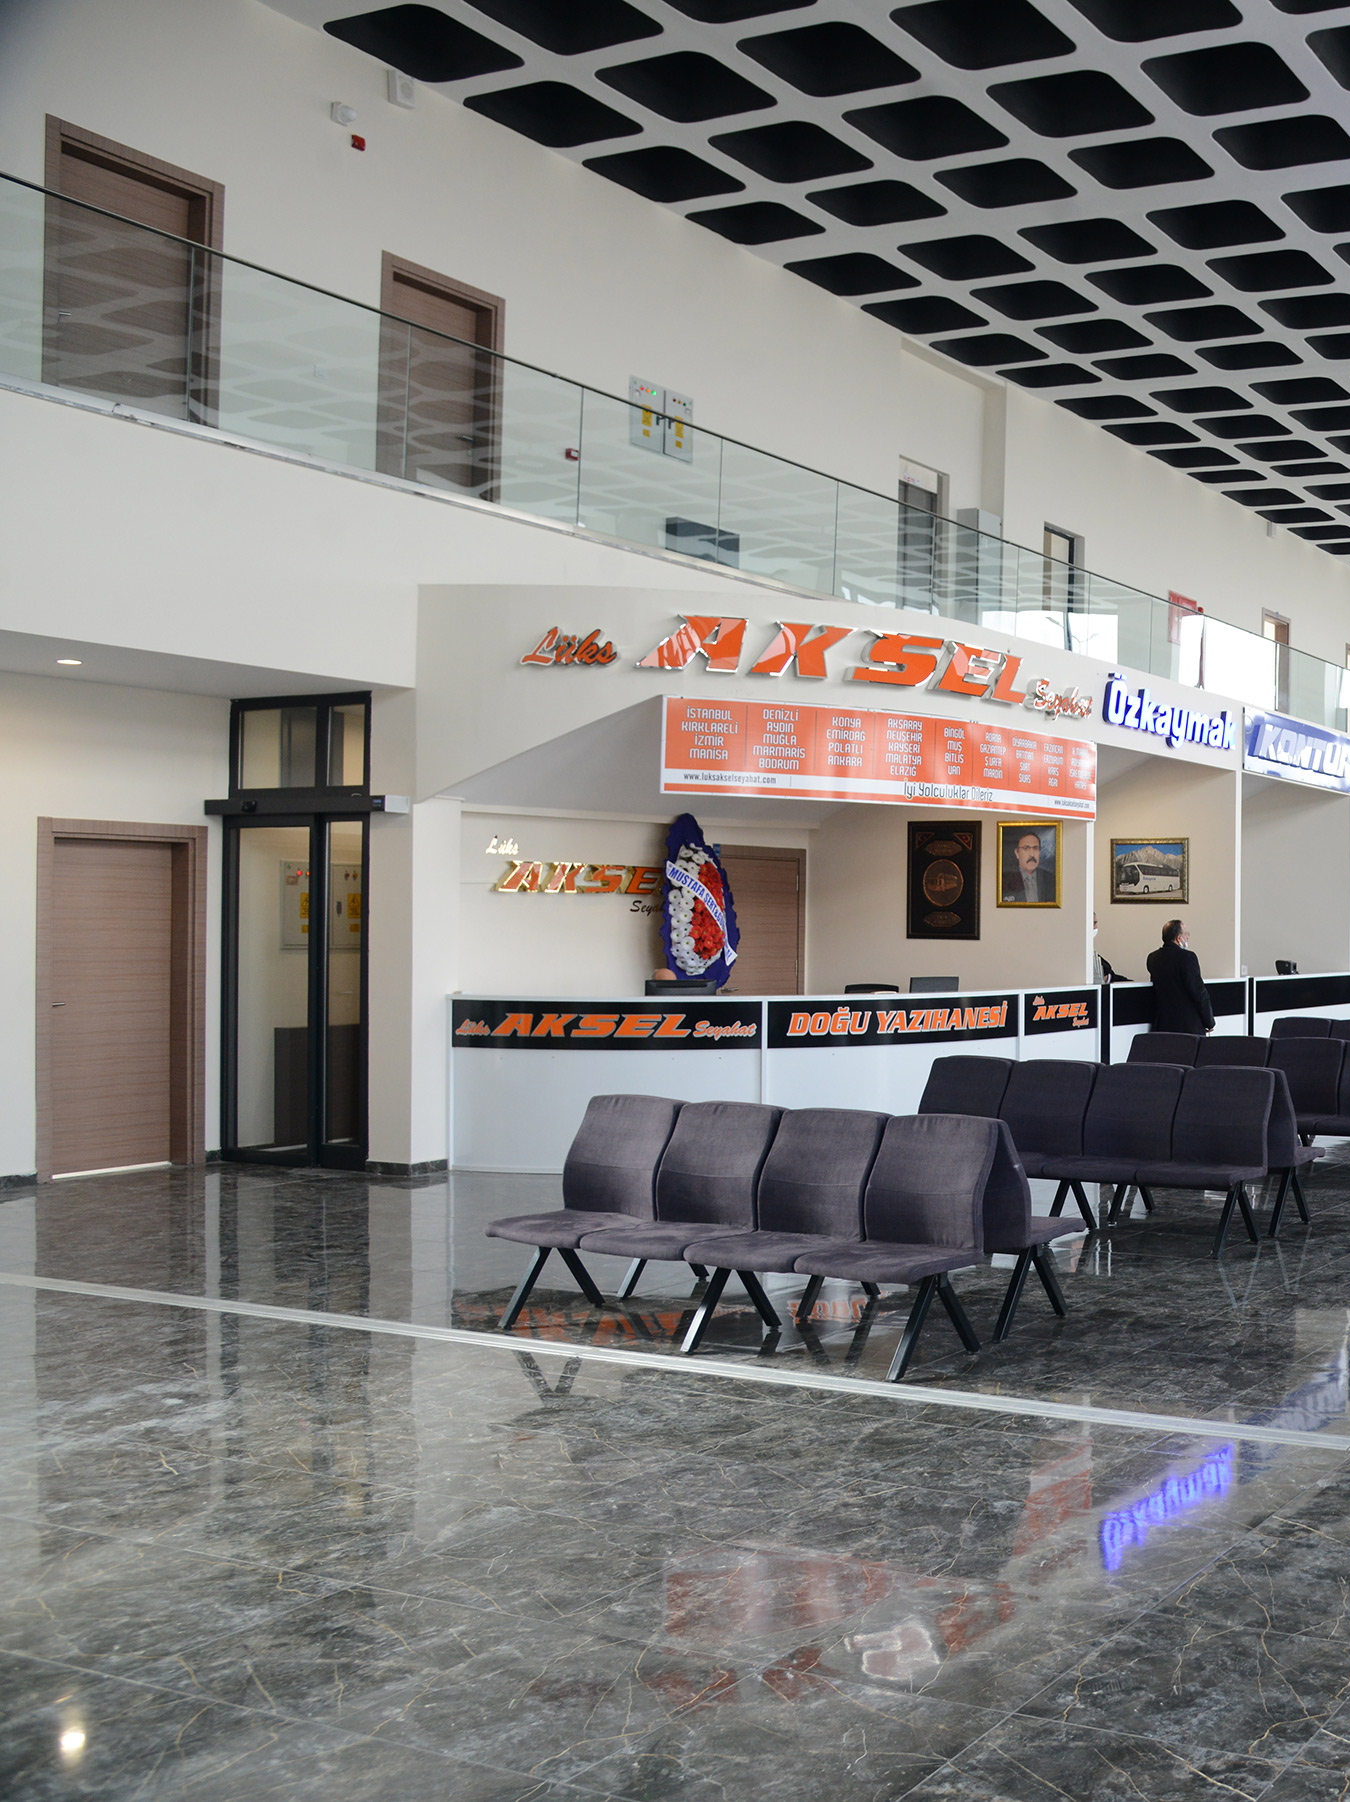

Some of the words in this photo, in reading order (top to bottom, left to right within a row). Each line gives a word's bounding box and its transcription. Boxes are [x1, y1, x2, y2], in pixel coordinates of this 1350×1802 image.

[520, 626, 620, 666] Lüks
[633, 613, 1028, 706] AKSEL
[686, 705, 733, 720] İSTANBUL
[762, 708, 799, 722] DENİZLİ
[1102, 672, 1238, 750] Özkaymak
[681, 721, 738, 734] KIRKLARELİ
[766, 722, 794, 733] AYDIN
[832, 716, 861, 728] KONYA
[887, 718, 923, 731] AKSARAY
[694, 733, 724, 746] İZMİR
[763, 732, 797, 746] MUĞLA
[826, 728, 866, 742] EMİRDAĞ
[944, 726, 966, 740] BİNGÖL
[752, 745, 806, 759] MARMARİS
[828, 742, 863, 754] POLATLI
[888, 742, 921, 754] KAYSERİ
[947, 740, 962, 753] MUŞ
[689, 747, 729, 760] MANİSA
[885, 753, 922, 766] MALATYA
[944, 751, 964, 764] BİTLİS
[758, 758, 800, 770] BODRUM
[828, 755, 863, 768] ANKARA
[890, 764, 917, 777] ELAZIĞ
[904, 779, 916, 800] İyi
[918, 782, 970, 800] Yolculuklar
[493, 860, 666, 895] AKSE
[669, 867, 705, 898] MUSTAFA
[786, 1006, 871, 1036] DOĞU
[876, 1001, 1008, 1034] YAZIHANESİ
[1033, 1002, 1089, 1022] AKSEL
[455, 1018, 491, 1036] Lüks
[490, 1012, 692, 1038] AKSEL
[692, 1019, 758, 1041] Seyahat
